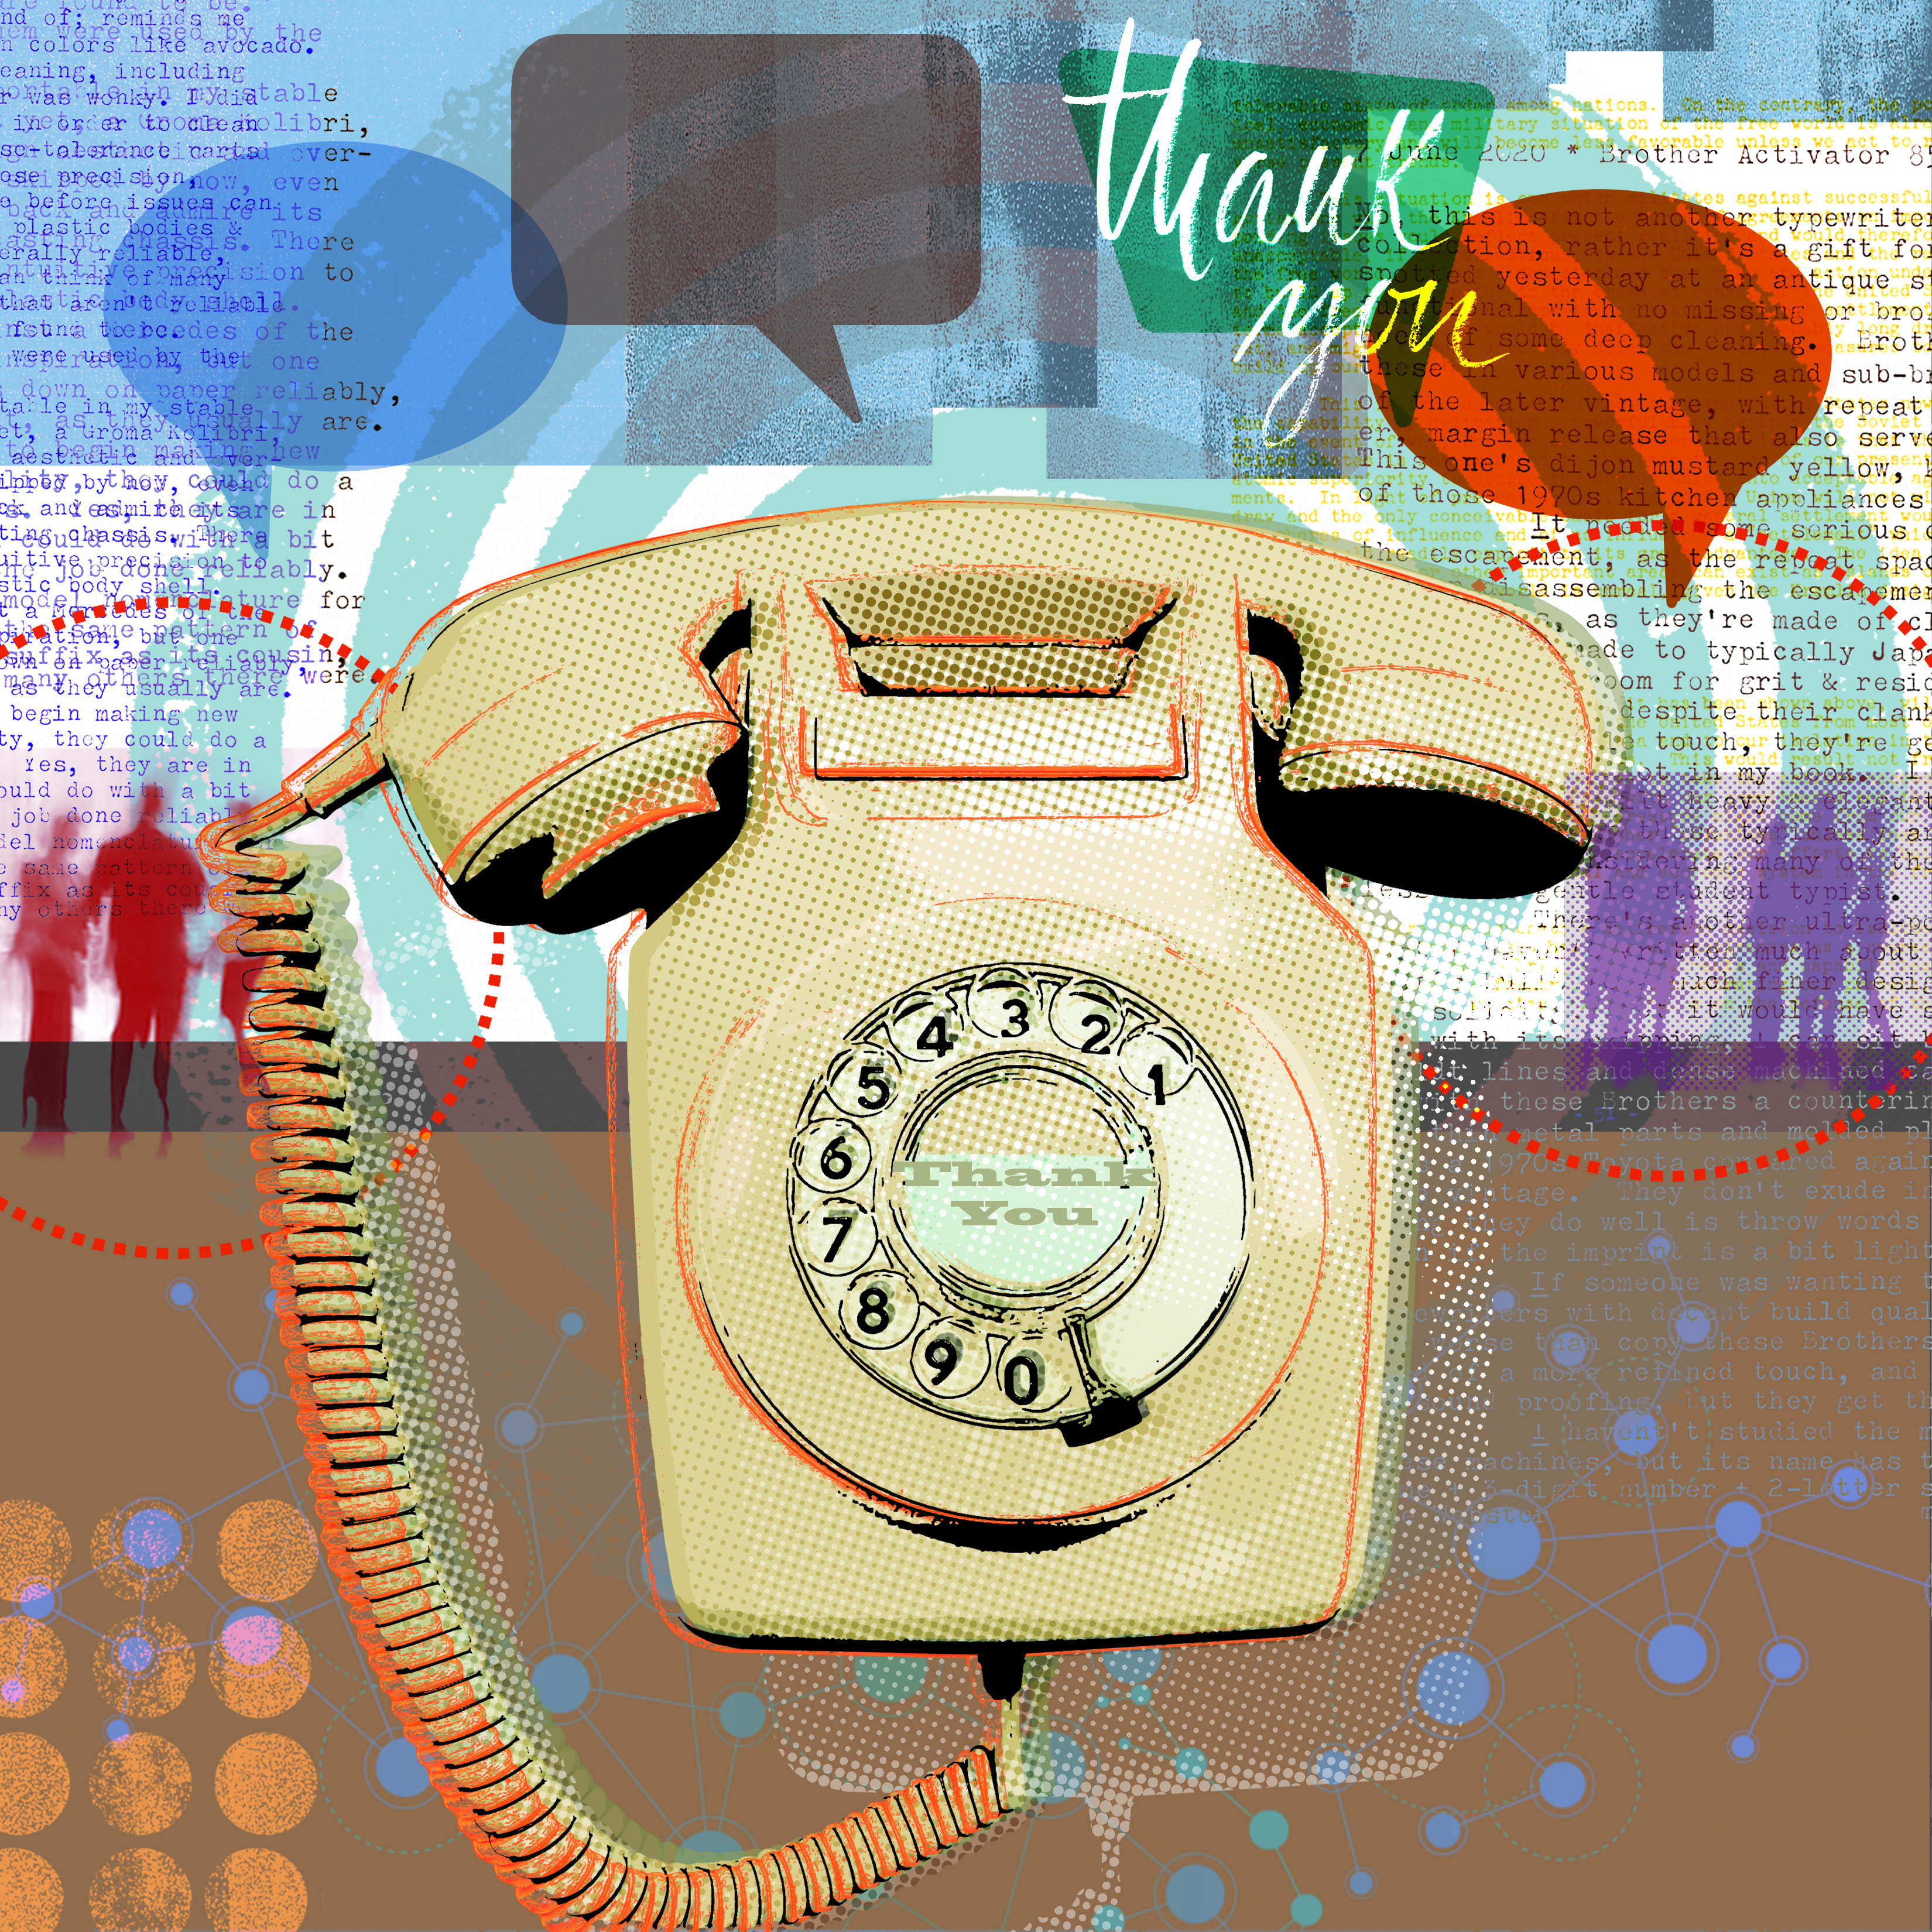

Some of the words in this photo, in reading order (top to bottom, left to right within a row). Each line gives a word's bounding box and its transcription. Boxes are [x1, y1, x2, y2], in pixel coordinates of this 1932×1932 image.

[102, 11, 201, 27] reminds
[218, 12, 245, 26] me
[29, 37, 114, 53] colors
[131, 36, 186, 53] like
[204, 36, 314, 54] avocado.
[115, 63, 245, 83] including
[1062, 18, 1451, 281] thank
[1389, 145, 1457, 160] June
[1479, 144, 1545, 162] 2020
[1599, 144, 1718, 163] Brother
[1738, 145, 1889, 164] Activator
[1736, 193, 1812, 207] against
[15, 220, 109, 235] plastic
[129, 220, 213, 235] bodies
[1429, 205, 1494, 225] this
[1514, 207, 1546, 225] is
[1567, 207, 1614, 227] not
[1636, 207, 1752, 227] another
[1566, 237, 1666, 257] rather
[1687, 237, 1753, 257] it's
[1774, 243, 1789, 257] a
[1808, 238, 1872, 262] gift
[1359, 263, 1477, 283] spotted
[1497, 266, 1649, 292] yesterday
[1670, 268, 1701, 287] at
[1722, 272, 1754, 287] an
[1773, 269, 1889, 294] antique
[1549, 297, 1616, 318] with
[1639, 304, 1666, 318] no
[1687, 300, 1805, 324] missing
[1825, 306, 1855, 320] or
[1499, 332, 1563, 347] some
[1585, 330, 1651, 353] deep
[1671, 330, 1816, 355] cleaning.
[1234, 279, 1510, 447] you
[1362, 357, 1442, 377] these
[1464, 359, 1495, 377] in
[1518, 359, 1633, 381] various
[1653, 363, 1754, 382] models
[1774, 364, 1821, 383] and
[257, 382, 399, 407] reliably,
[1359, 390, 1390, 409] of
[1414, 392, 1459, 410] the
[1480, 392, 1564, 410] later
[1584, 395, 1716, 419] vintage,
[1738, 396, 1806, 415] with
[1824, 396, 1921, 420] repeat
[323, 413, 381, 431] are.
[1427, 424, 1531, 447] margin
[1550, 425, 1667, 446] release
[1690, 429, 1752, 446] that
[1774, 427, 1837, 446] also
[1359, 448, 1426, 470] This
[1445, 453, 1530, 472] one's
[1550, 455, 1634, 475] dijon
[1652, 457, 1769, 475] mustard
[1790, 457, 1903, 483] yellow,
[1359, 484, 1390, 502] of
[1413, 484, 1495, 504] those
[1519, 485, 1600, 508] 1970s
[1619, 488, 1736, 507] kitchen
[1756, 489, 1924, 511] appliances
[1531, 512, 1564, 539] It
[1791, 520, 1906, 539] serious
[1363, 542, 1409, 561] the
[1639, 553, 1669, 568] as
[1690, 549, 1736, 568] the
[322, 590, 365, 609] for
[1724, 581, 1770, 600] the
[1587, 614, 1618, 628] as
[1639, 608, 1753, 632] they're
[1773, 611, 1837, 629] made
[1656, 641, 1686, 659] to
[1708, 642, 1854, 666] typically
[1673, 672, 1718, 690] for
[1741, 672, 1803, 694] grit
[1822, 673, 1837, 690] &
[12, 705, 80, 728] begin
[95, 704, 179, 727] making
[196, 709, 238, 722] new
[1621, 701, 1736, 722] despite
[1758, 702, 1837, 720] their
[54, 731, 107, 753] they
[125, 730, 193, 747] could
[210, 731, 238, 747] do
[254, 735, 266, 748] a
[1657, 734, 1750, 756] touch,
[1775, 732, 1886, 755] they're
[25, 758, 77, 776] Yes,
[97, 756, 150, 778] they
[168, 761, 207, 773] are
[224, 757, 251, 773] in
[1688, 763, 1720, 781] in
[1738, 766, 1770, 785] my
[1790, 761, 1867, 782] book.
[1906, 761, 1917, 779] I
[68, 782, 93, 799] do
[110, 782, 165, 799] with
[210, 781, 251, 799] bit
[68, 806, 121, 822] done
[1690, 793, 1770, 814] heavy
[1656, 881, 1769, 900] student
[1791, 882, 1899, 905] typist.
[1755, 941, 1820, 960] much
[1840, 941, 1918, 961] about
[1002, 999, 1029, 1037] 3
[1838, 1001, 1902, 1019] have
[917, 1016, 953, 1056] 4
[1081, 1014, 1111, 1054] 2
[1482, 1062, 1566, 1080] lines
[857, 1066, 889, 1109] 5
[1147, 1064, 1166, 1105] 1
[1501, 1092, 1581, 1111] these
[1603, 1092, 1735, 1111] Brothers
[1755, 1097, 1769, 1110] a
[1622, 1125, 1701, 1146] parts
[1722, 1123, 1769, 1140] and
[820, 1136, 851, 1180] 6
[893, 1161, 1157, 1187] Thank
[1617, 1182, 1684, 1205] They
[1703, 1182, 1784, 1200] don't
[1806, 1182, 1885, 1199] exude
[951, 1200, 1098, 1226] You
[1602, 1211, 1666, 1231] well
[1686, 1212, 1718, 1231] is
[1738, 1211, 1817, 1229] throw
[1838, 1211, 1919, 1229] words
[823, 1217, 852, 1263] 7
[1789, 1242, 1834, 1260] bit
[1585, 1276, 1699, 1292] someone
[1719, 1276, 1768, 1290] was
[1787, 1271, 1902, 1295] wanting
[857, 1288, 889, 1334] 8
[1567, 1303, 1632, 1321] with
[1770, 1301, 1851, 1321] build
[924, 1339, 957, 1386] 9
[1618, 1363, 1733, 1381] refined
[1756, 1363, 1847, 1385] touch,
[1871, 1361, 1917, 1381] and
[1004, 1356, 1038, 1406] 0
[1755, 1393, 1816, 1415] they
[1837, 1393, 1883, 1413] get
[1620, 1480, 1715, 1498] number
